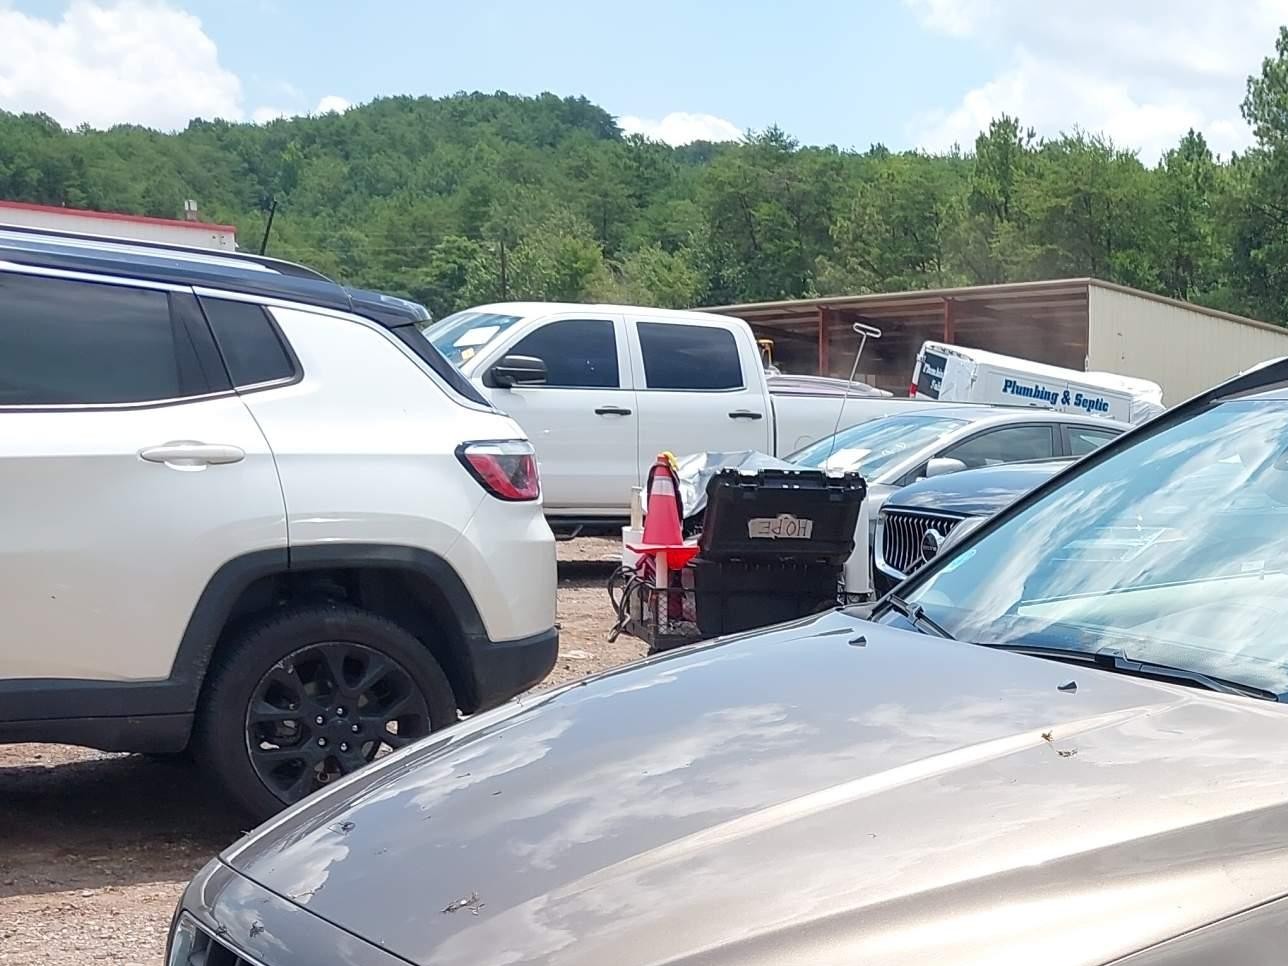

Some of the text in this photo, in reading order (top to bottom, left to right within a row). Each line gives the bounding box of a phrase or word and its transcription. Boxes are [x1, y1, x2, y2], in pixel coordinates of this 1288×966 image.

[1002, 379, 1109, 412] Plumbing & Septic
[758, 520, 807, 537] HOPE
